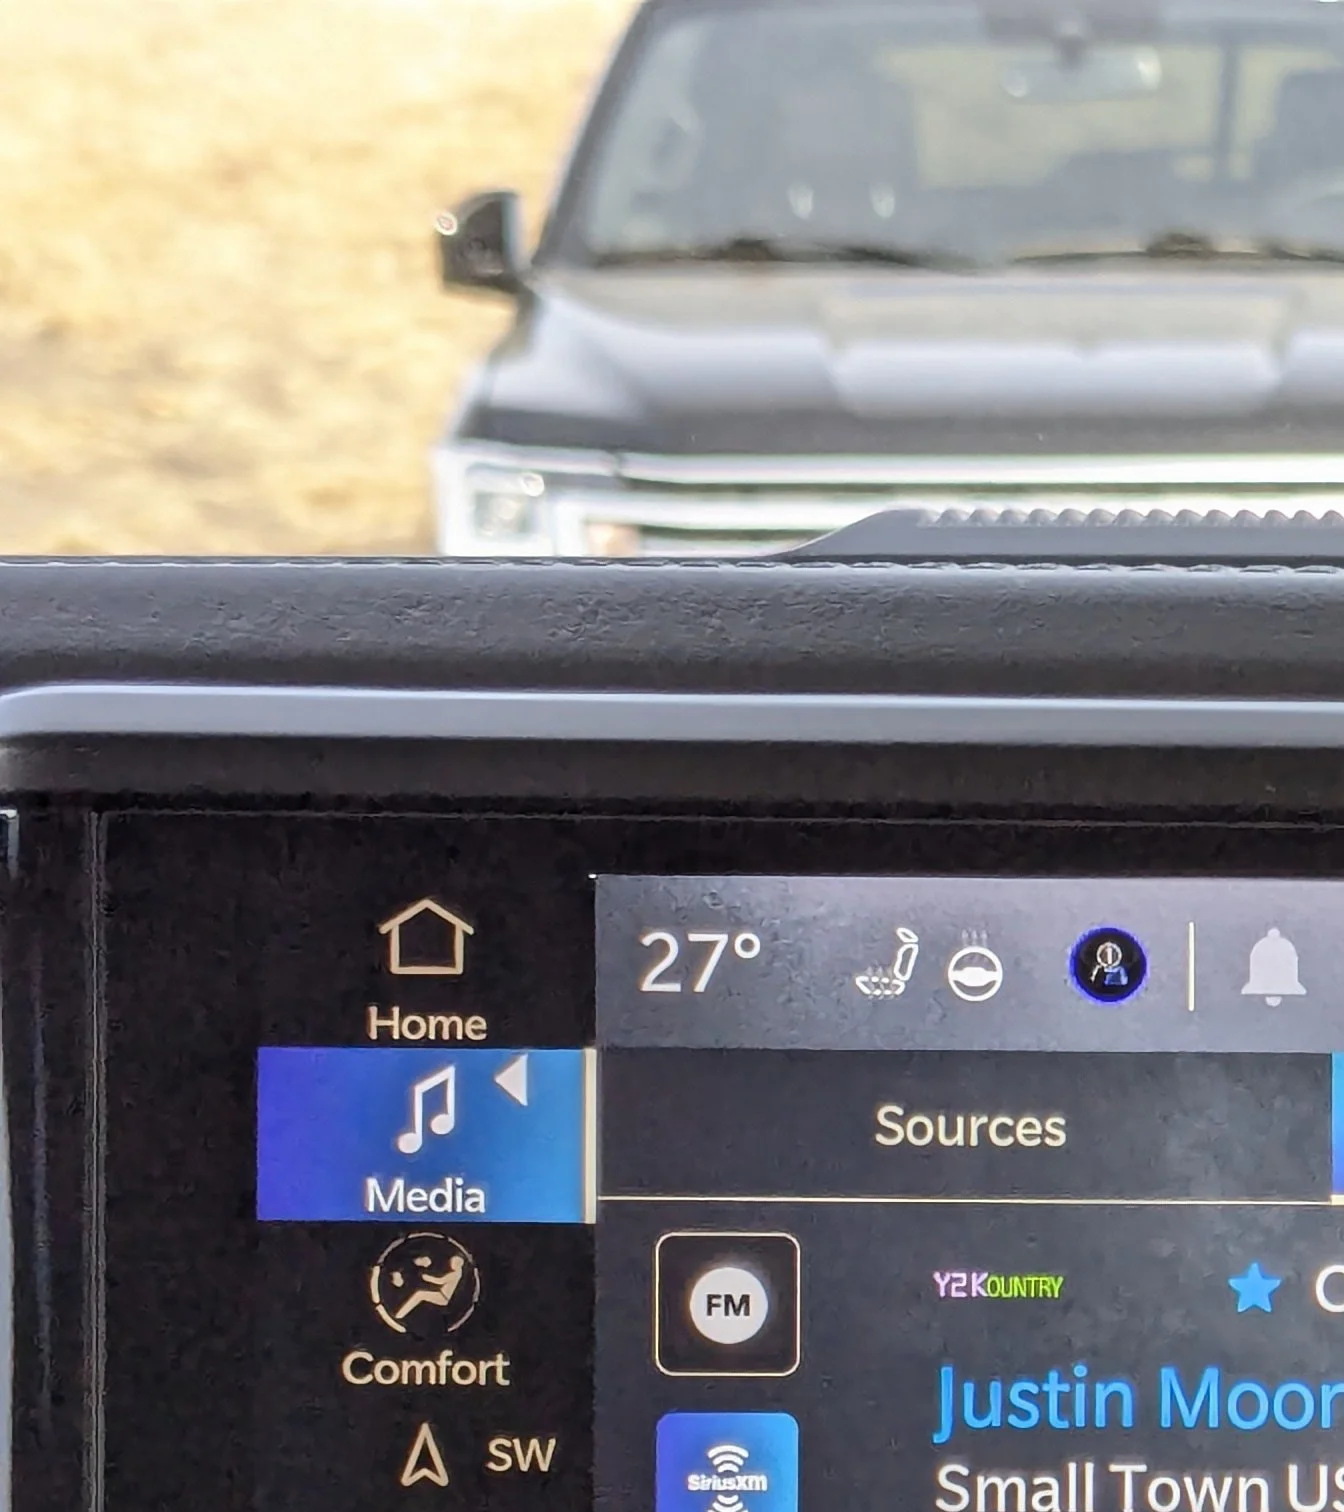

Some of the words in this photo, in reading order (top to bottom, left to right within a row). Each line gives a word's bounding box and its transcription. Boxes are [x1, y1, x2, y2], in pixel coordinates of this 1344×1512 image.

[639, 932, 762, 994] 27°
[367, 1007, 487, 1041] Home
[875, 1105, 1067, 1147] Sources
[365, 1179, 486, 1214] Media
[706, 1295, 751, 1318] FM
[341, 1351, 511, 1387] Comfort
[932, 1365, 1137, 1445] Justin
[486, 1438, 558, 1473] SW
